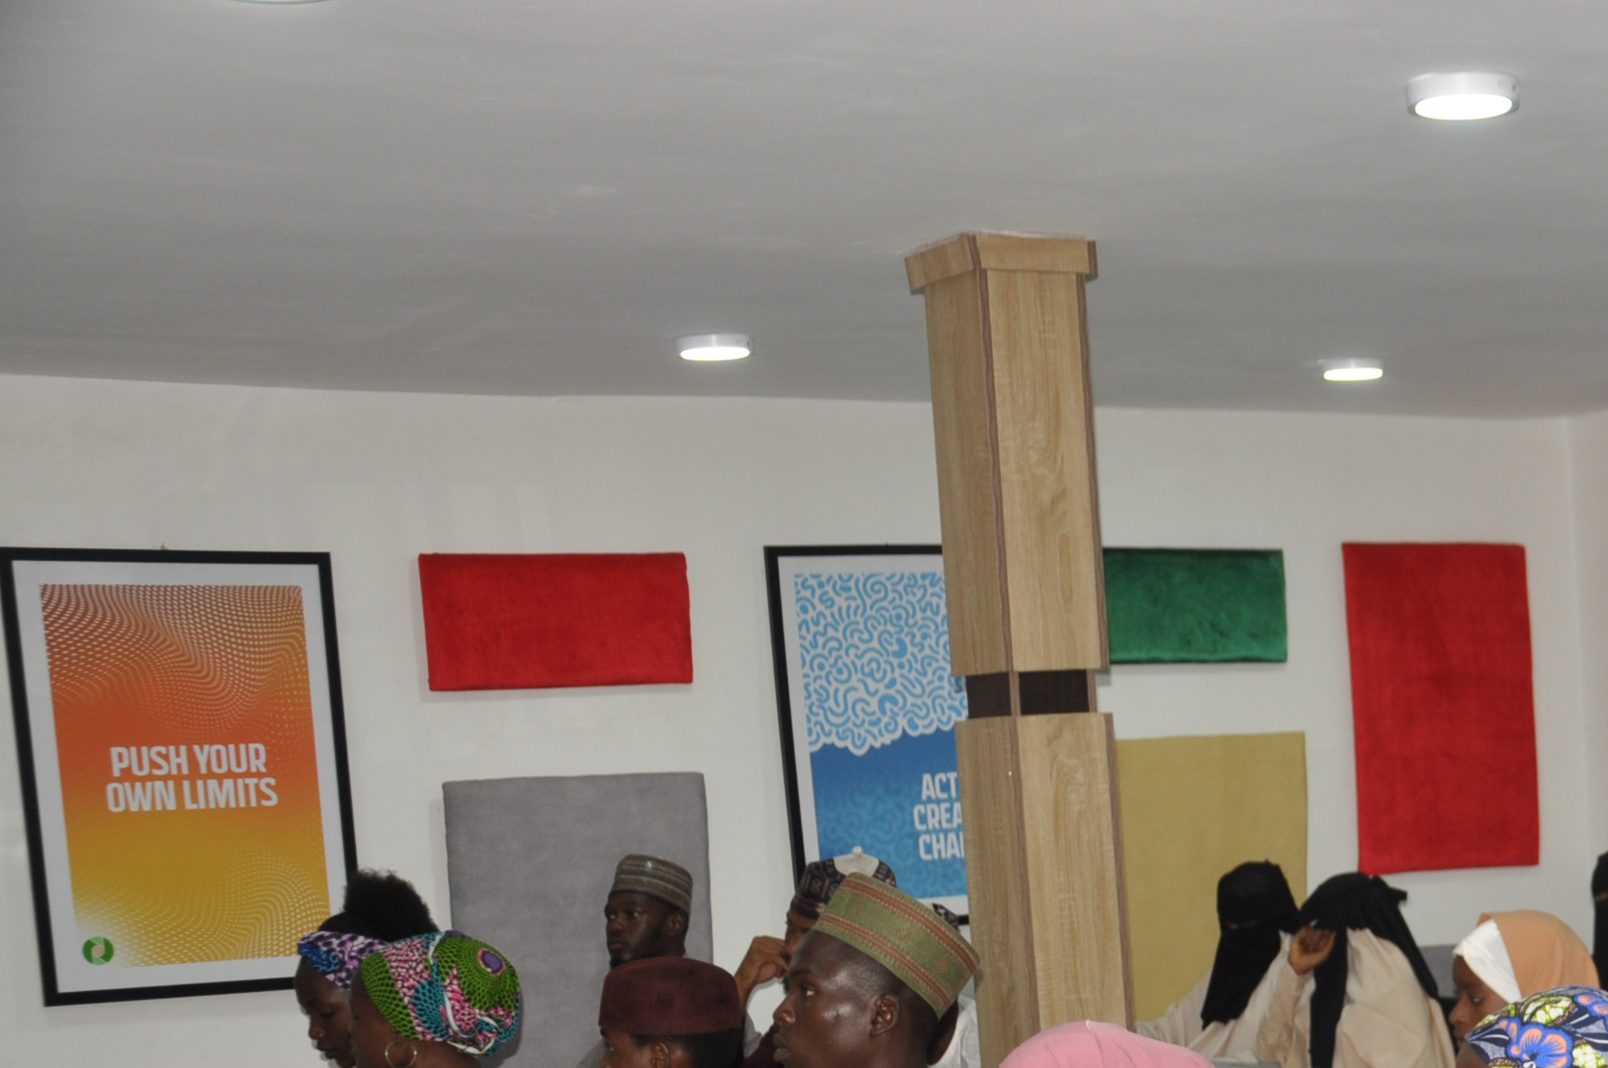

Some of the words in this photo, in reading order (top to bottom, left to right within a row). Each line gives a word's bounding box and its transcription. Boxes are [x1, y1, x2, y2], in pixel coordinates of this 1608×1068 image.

[110, 746, 189, 777] PUSH
[193, 743, 267, 774] YOUR
[106, 780, 176, 812] OWN
[182, 777, 278, 807] LIMITS
